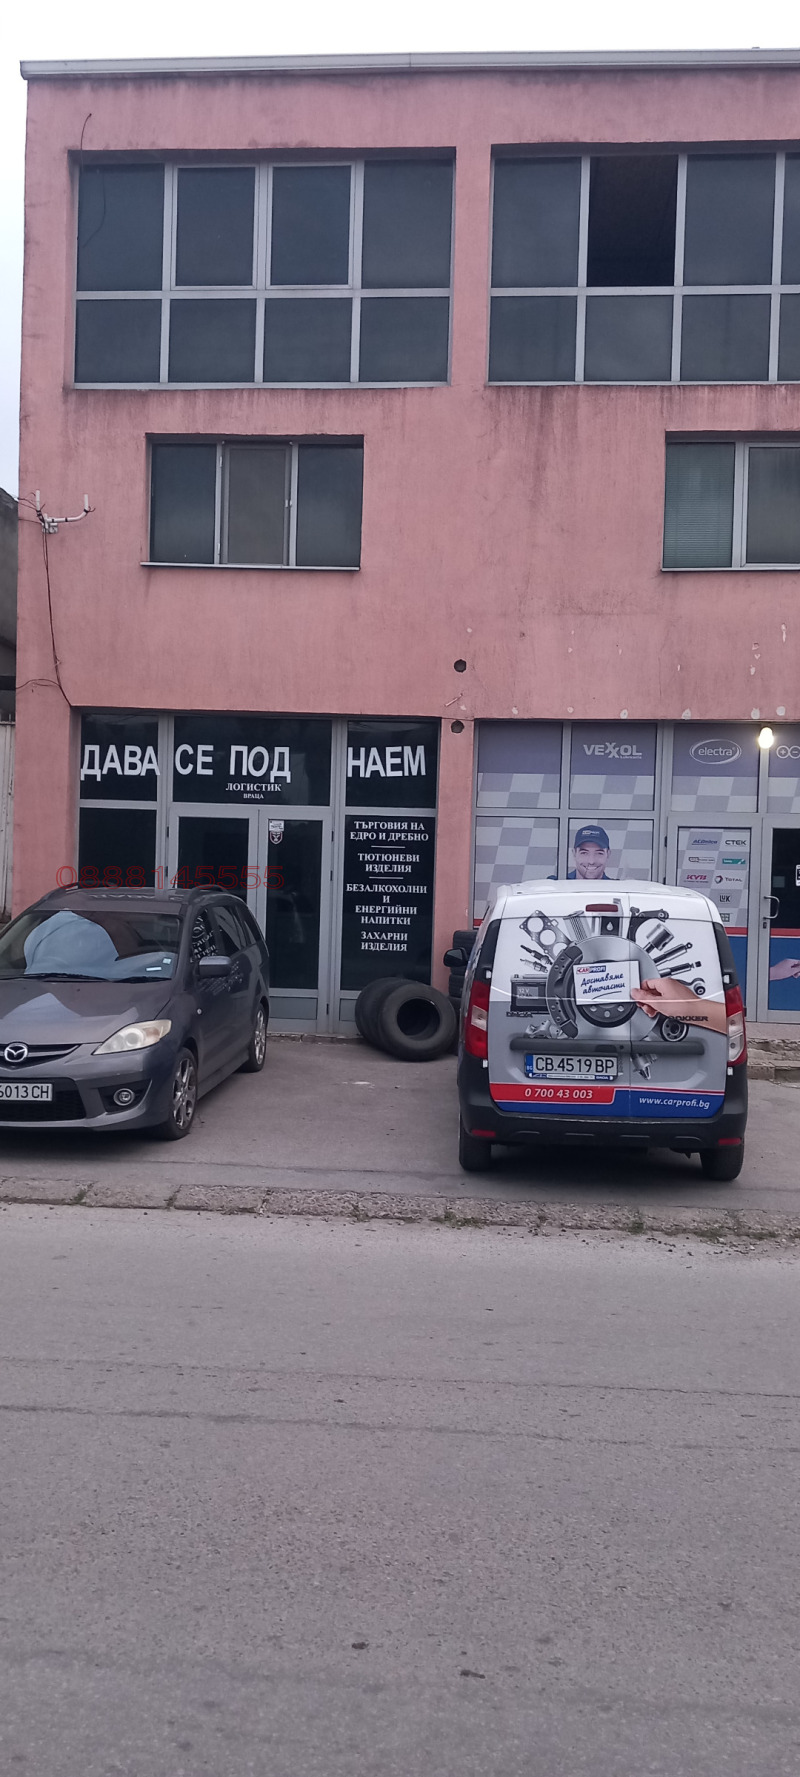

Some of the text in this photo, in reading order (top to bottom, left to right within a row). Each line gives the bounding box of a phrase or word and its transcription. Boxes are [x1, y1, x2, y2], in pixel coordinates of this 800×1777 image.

[80, 743, 426, 783] ДАВА СЕ ПОД НАЕМ
[225, 783, 282, 792] ЛОГИСТИК
[353, 821, 425, 831] ТЪРГОВИЯ НА
[350, 832, 429, 842] ЕДРО И ДРЕБНО
[357, 853, 420, 863] ТЮТЮНЕВИ
[365, 864, 412, 874] ИЗДЕЛИЯ
[346, 883, 428, 894] БЕЗАЛКОХОЛНИ
[382, 895, 391, 903] И
[355, 904, 418, 915] ЕНЕРГИЙНИ
[360, 916, 411, 925] НАПИТКИ
[360, 931, 408, 941] ЗАХАРНИ
[360, 942, 408, 952] ИЗДЕЛИЯ
[580, 973, 624, 987] Доставяме
[582, 983, 626, 994] авточасти
[534, 1088, 554, 1097] 700
[556, 1089, 570, 1098] 43
[572, 1090, 593, 1099] 003
[639, 1097, 710, 1109] www.carprofi.bg
